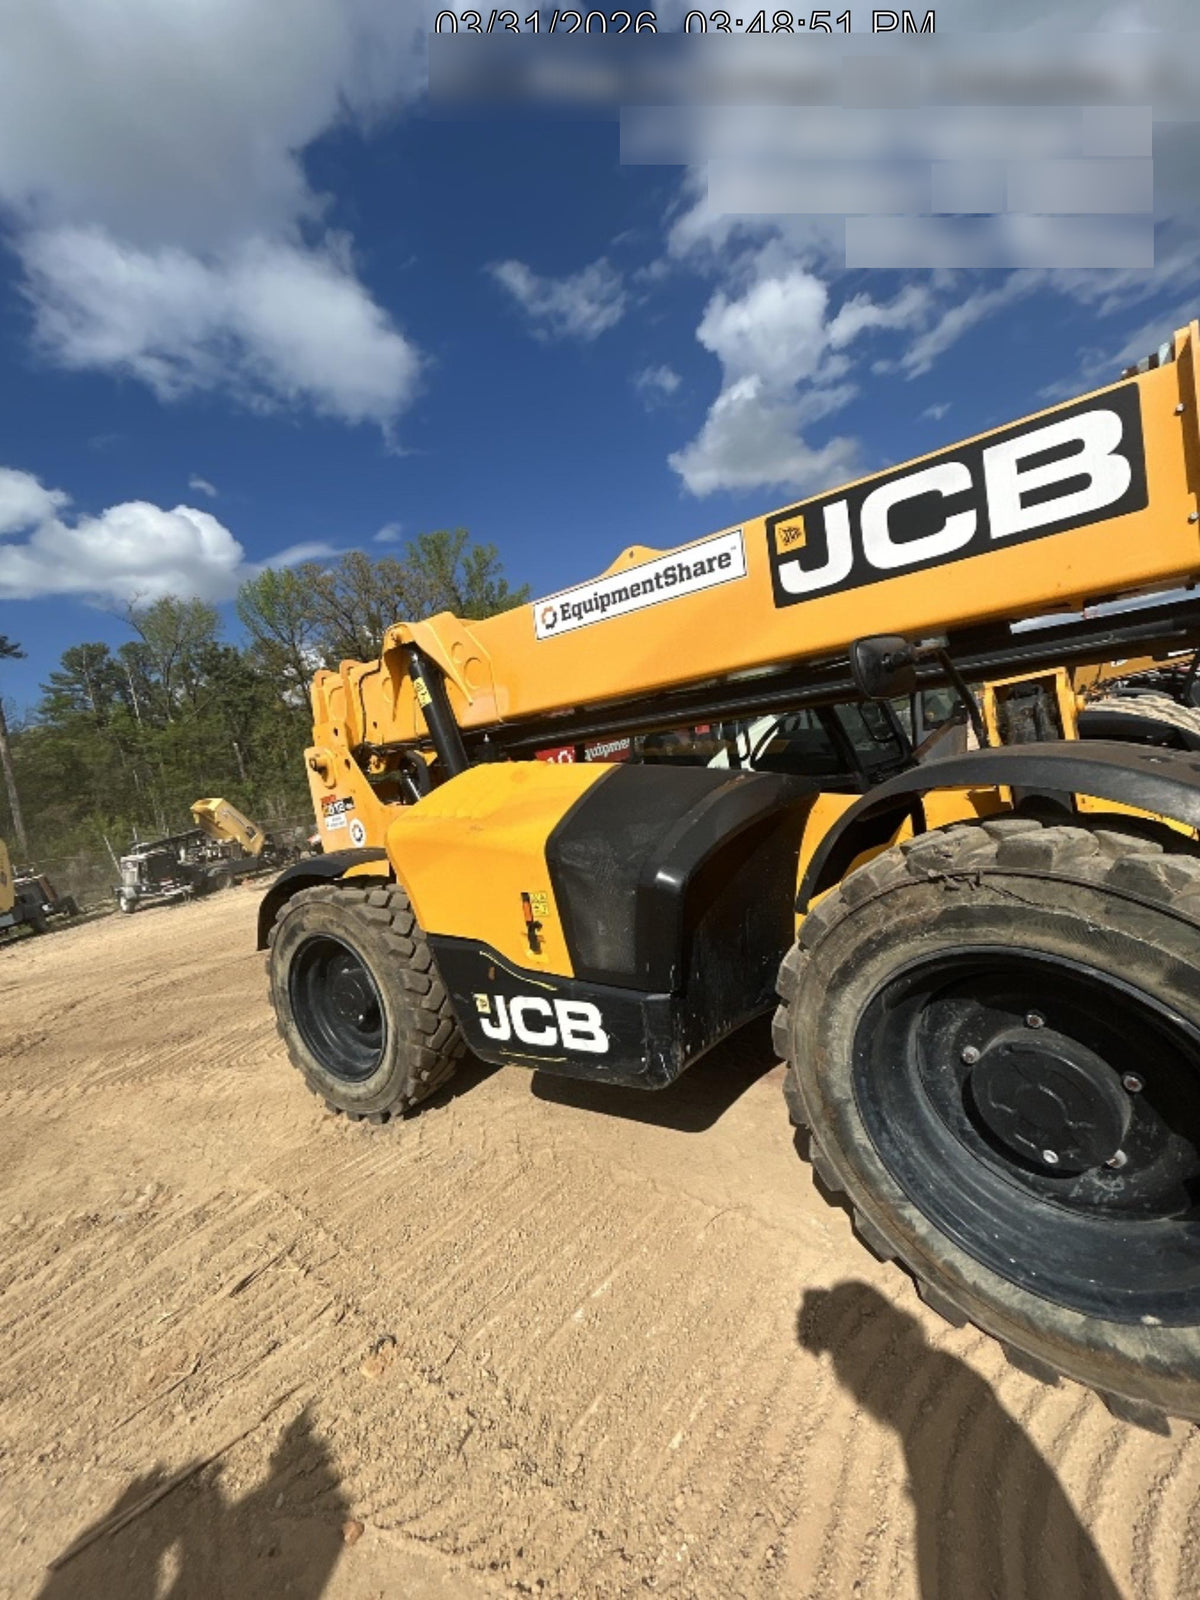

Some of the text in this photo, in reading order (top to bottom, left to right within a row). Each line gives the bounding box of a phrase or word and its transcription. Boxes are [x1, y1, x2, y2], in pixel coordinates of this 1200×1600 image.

[778, 409, 1132, 594] JCB
[560, 551, 732, 622] EquipmentShare
[480, 995, 609, 1053] JCB
